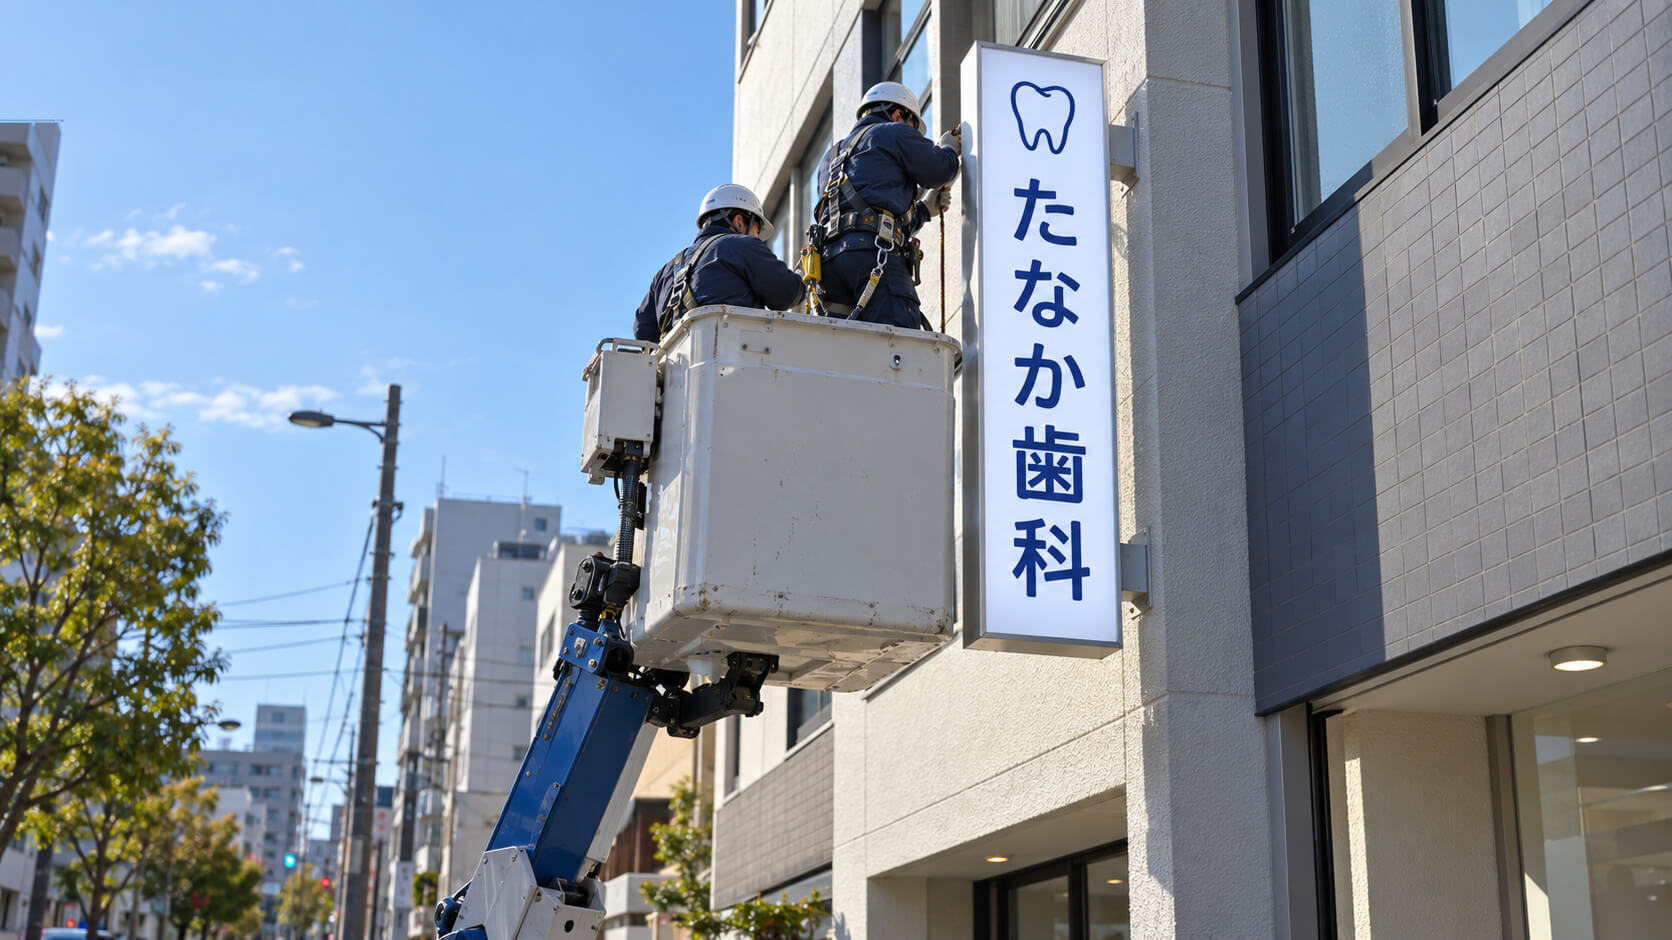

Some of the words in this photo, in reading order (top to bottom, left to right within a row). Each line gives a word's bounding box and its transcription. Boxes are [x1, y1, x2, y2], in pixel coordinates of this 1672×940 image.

[1012, 178, 1091, 602] たなか歯科
